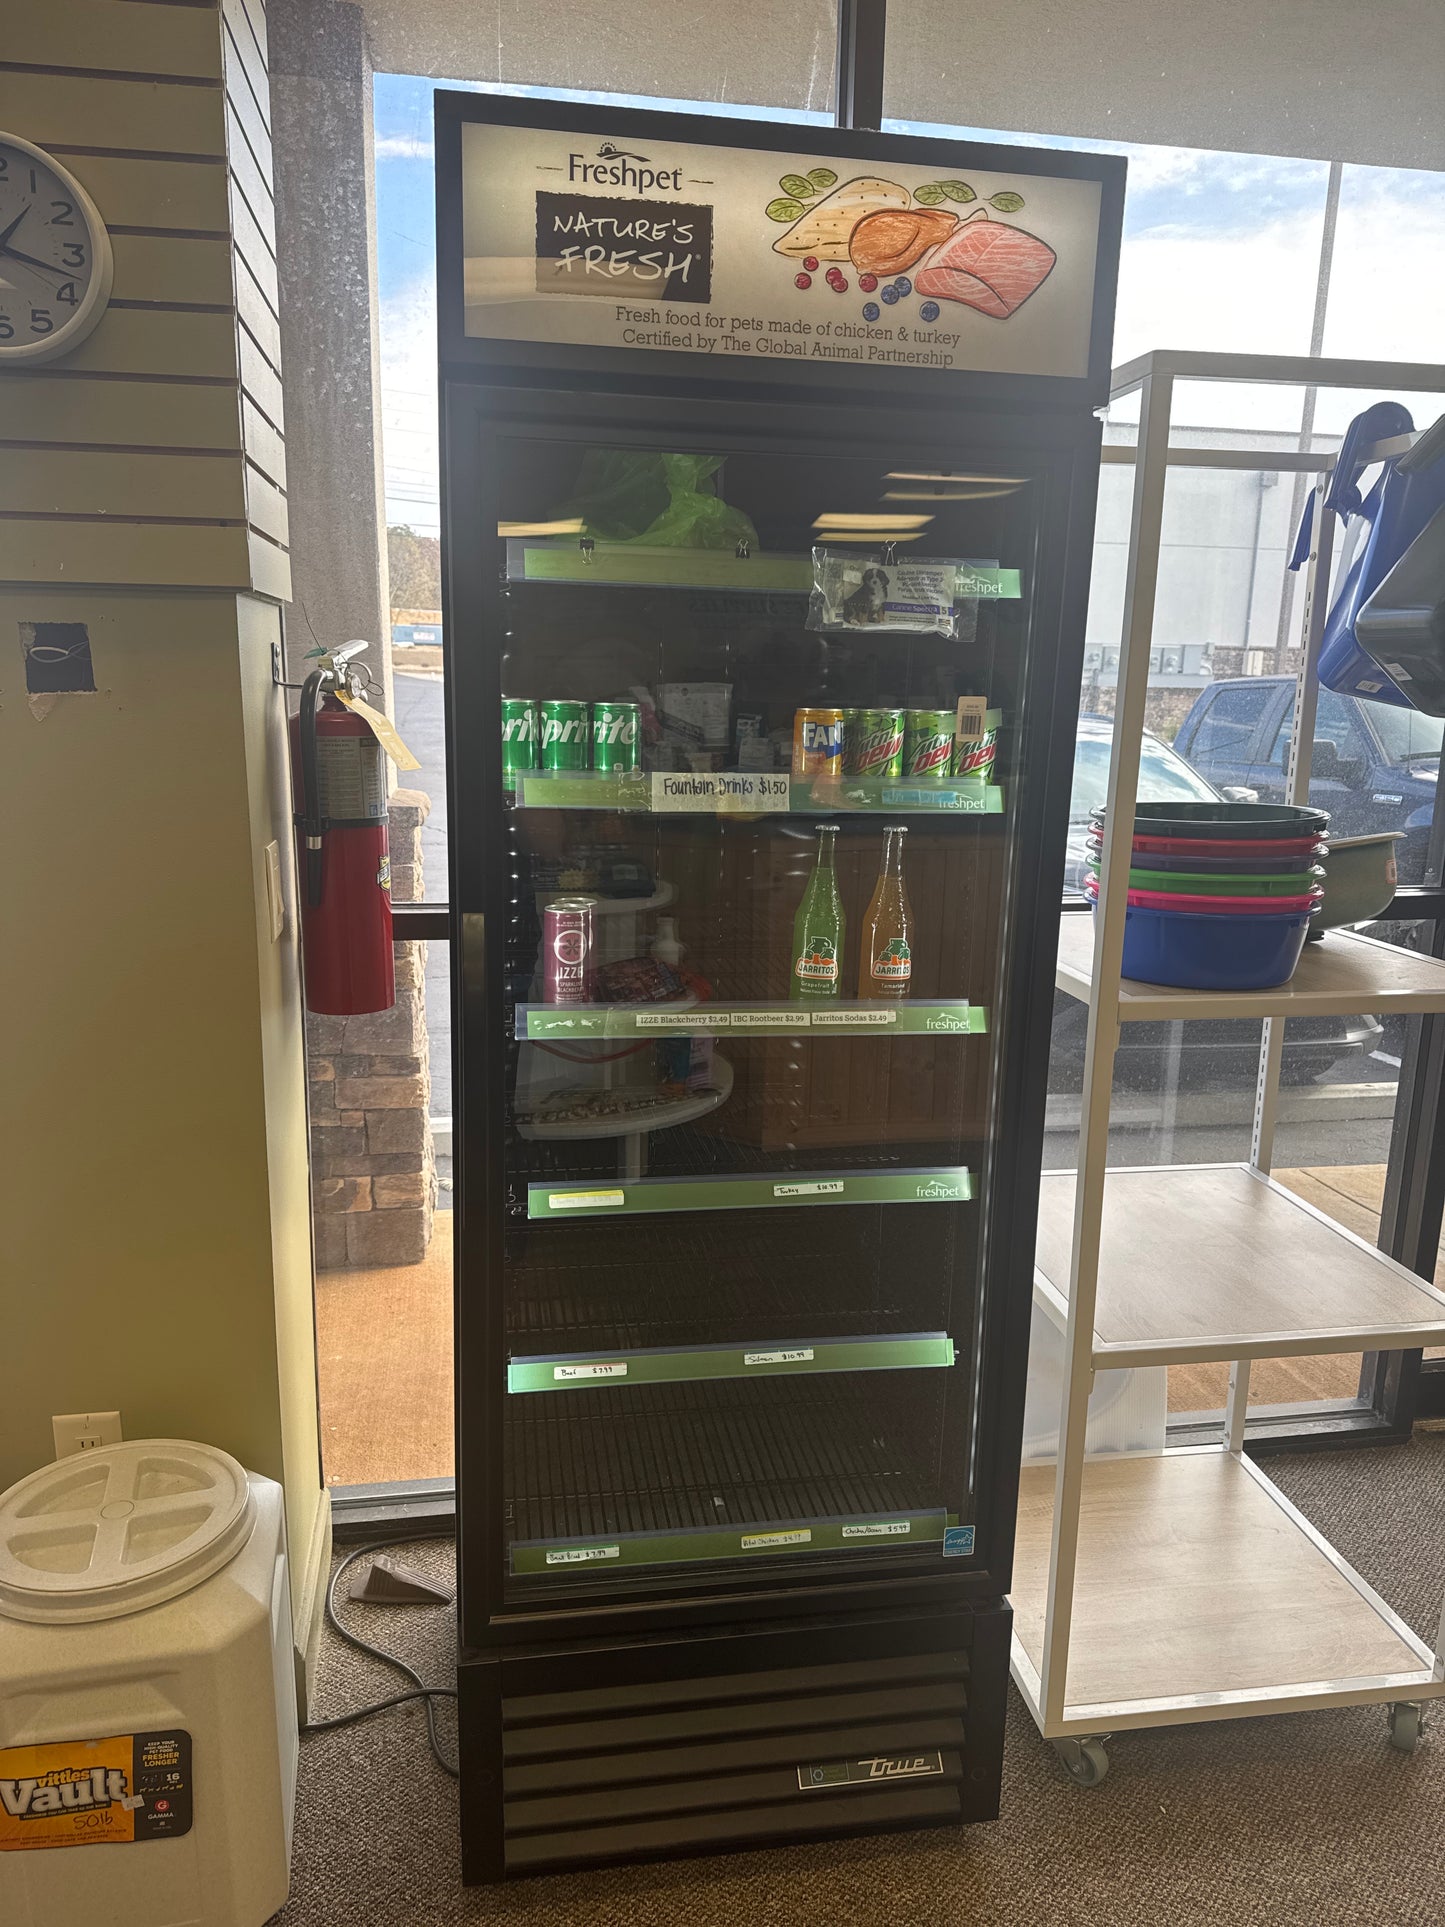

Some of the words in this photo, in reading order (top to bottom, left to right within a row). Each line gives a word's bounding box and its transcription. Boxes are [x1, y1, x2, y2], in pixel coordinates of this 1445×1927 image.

[30, 169, 36, 194] 1
[569, 153, 682, 194] Freshpet
[51, 201, 74, 226] 2
[553, 212, 693, 243] NATURE'S
[62, 243, 85, 268] 3
[555, 245, 692, 282] FRESH
[56, 282, 79, 306] 4
[30, 309, 53, 333] 5
[615, 306, 660, 324] Fresh
[665, 310, 700, 326] food
[705, 312, 726, 328] for
[731, 317, 763, 333] pets
[768, 319, 811, 334] made
[816, 321, 832, 336] of
[834, 323, 893, 340] chicken
[897, 327, 908, 341] &
[913, 329, 960, 349] turkey
[623, 329, 692, 347] Certified
[697, 334, 717, 352] by
[721, 335, 751, 351] The
[755, 338, 806, 355] Global
[812, 342, 863, 359] Animal
[868, 346, 953, 368] Partnership
[802, 719, 845, 749] FAN
[663, 778, 714, 795] Fountain
[719, 777, 753, 795] Drinks
[758, 776, 787, 795] $1.50
[798, 965, 835, 975] JARRITOS
[876, 966, 909, 975] JARRITOS
[640, 1016, 659, 1024] IZZE
[660, 1016, 707, 1025] Blackcherry
[708, 1015, 728, 1023] $2.49
[734, 1015, 748, 1023] IBC
[785, 1014, 805, 1023] $2.99
[814, 1014, 843, 1022] Jarritos
[844, 1014, 867, 1022] Sodas
[868, 1014, 888, 1022] $2.49
[926, 1018, 971, 1031] freshpet
[916, 1185, 959, 1198] freshpet
[142, 1752, 180, 1761] FRESHER
[144, 1758, 178, 1767] LONGER
[858, 1757, 931, 1777] True
[37, 1769, 90, 1787] vittles
[166, 1773, 180, 1781] 16
[0, 1768, 127, 1815] Vault
[148, 1812, 174, 1820] GAMMA
